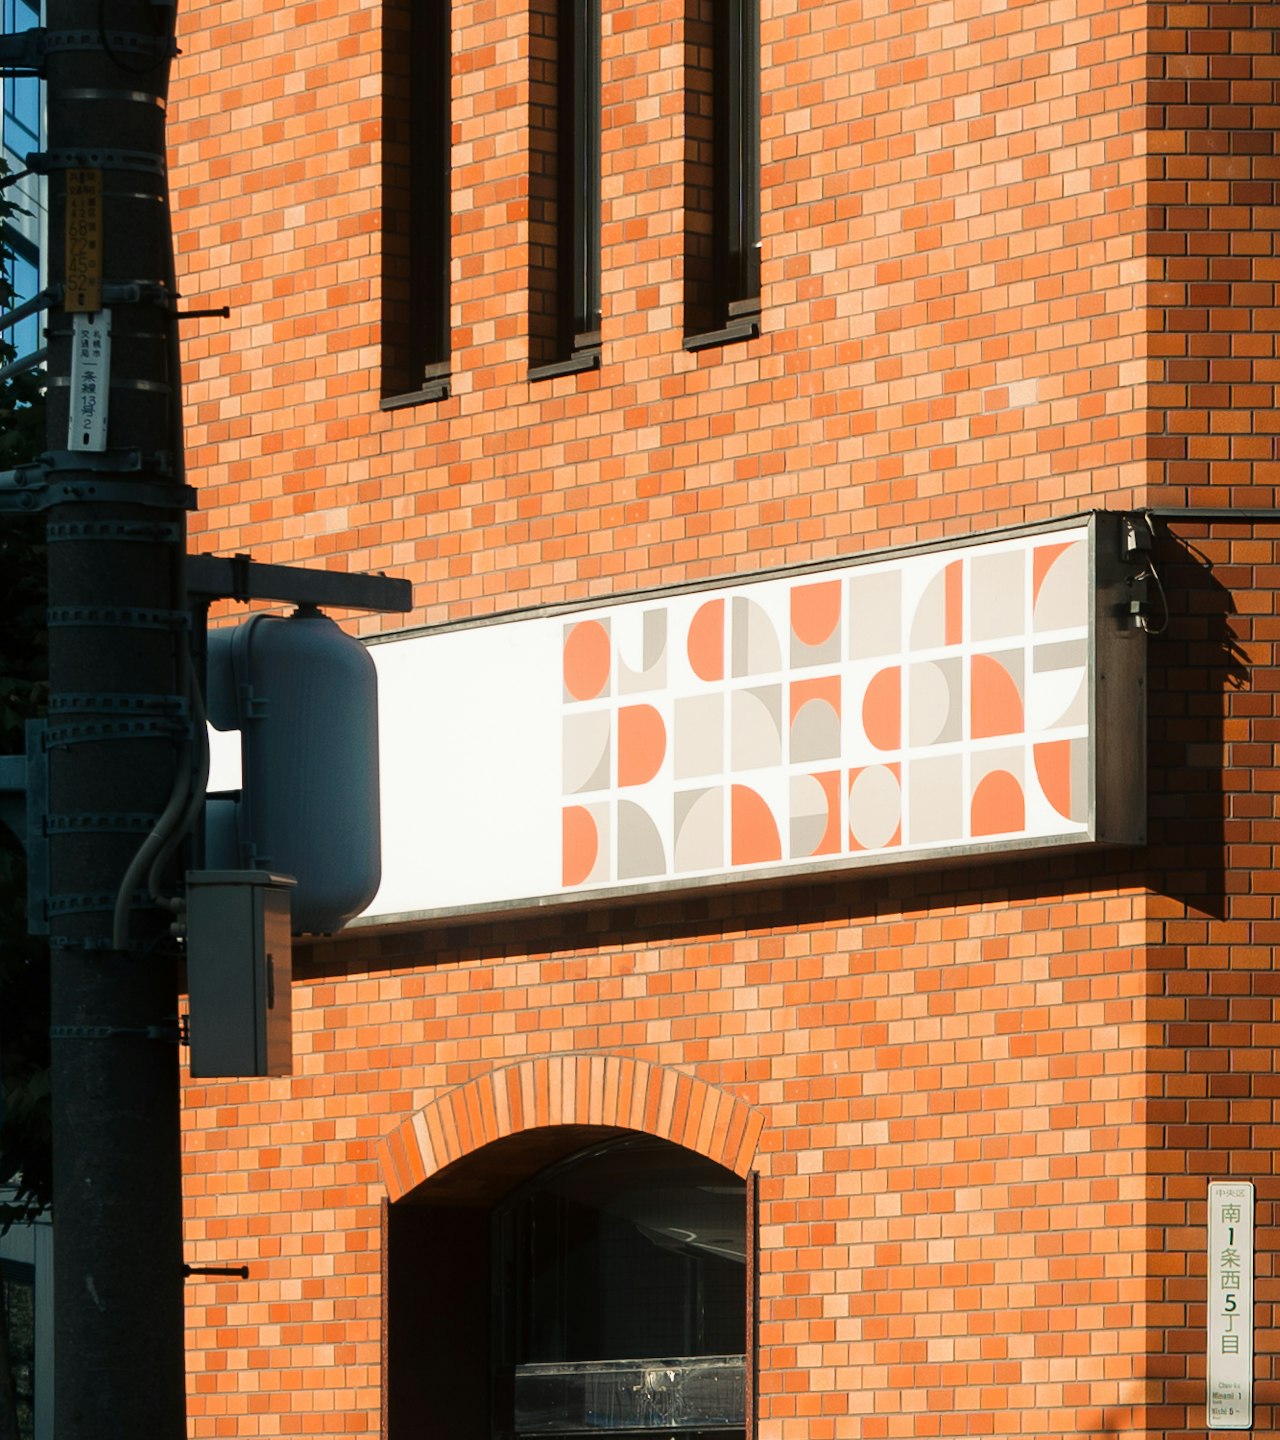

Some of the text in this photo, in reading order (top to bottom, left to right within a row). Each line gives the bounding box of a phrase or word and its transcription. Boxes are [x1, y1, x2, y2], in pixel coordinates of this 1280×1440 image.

[1220, 1203, 1241, 1355] 南1条西5丁目
